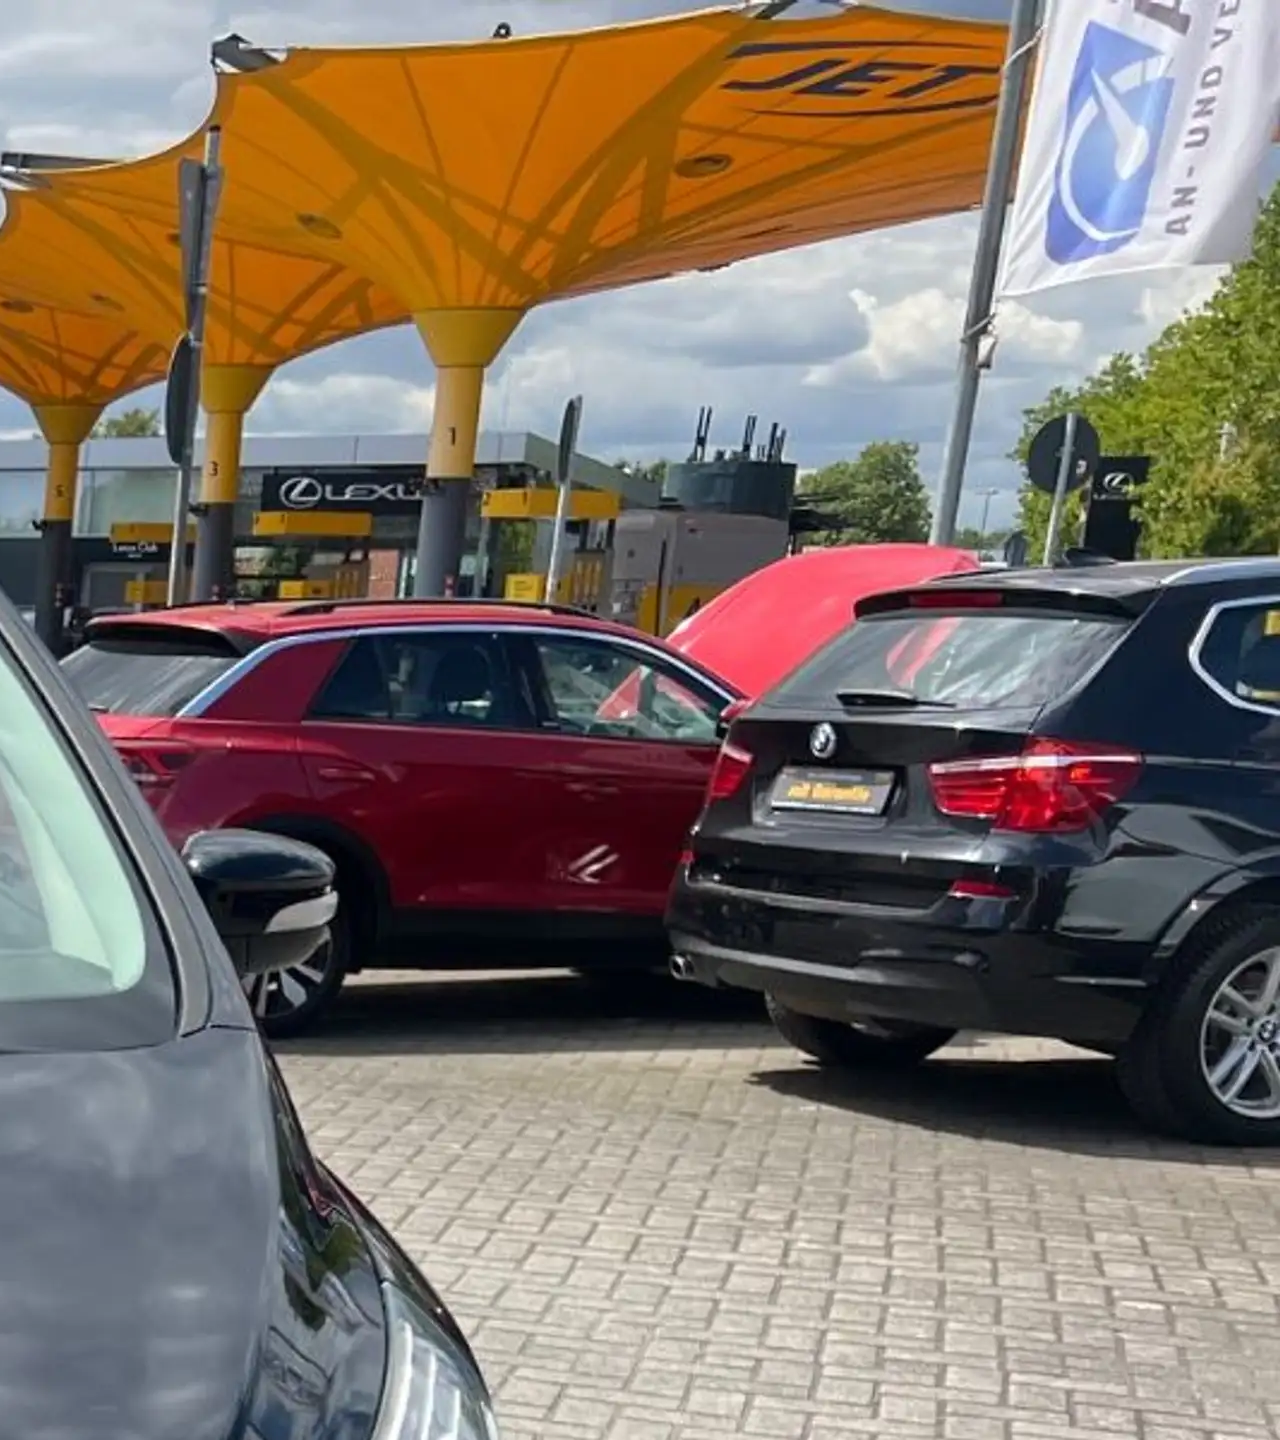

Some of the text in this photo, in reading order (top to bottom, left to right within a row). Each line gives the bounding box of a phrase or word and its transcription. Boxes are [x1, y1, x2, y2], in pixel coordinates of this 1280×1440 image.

[719, 58, 1000, 98] JET
[1184, 65, 1223, 149] UND
[448, 427, 457, 446] 1
[324, 484, 422, 501] LEXU
